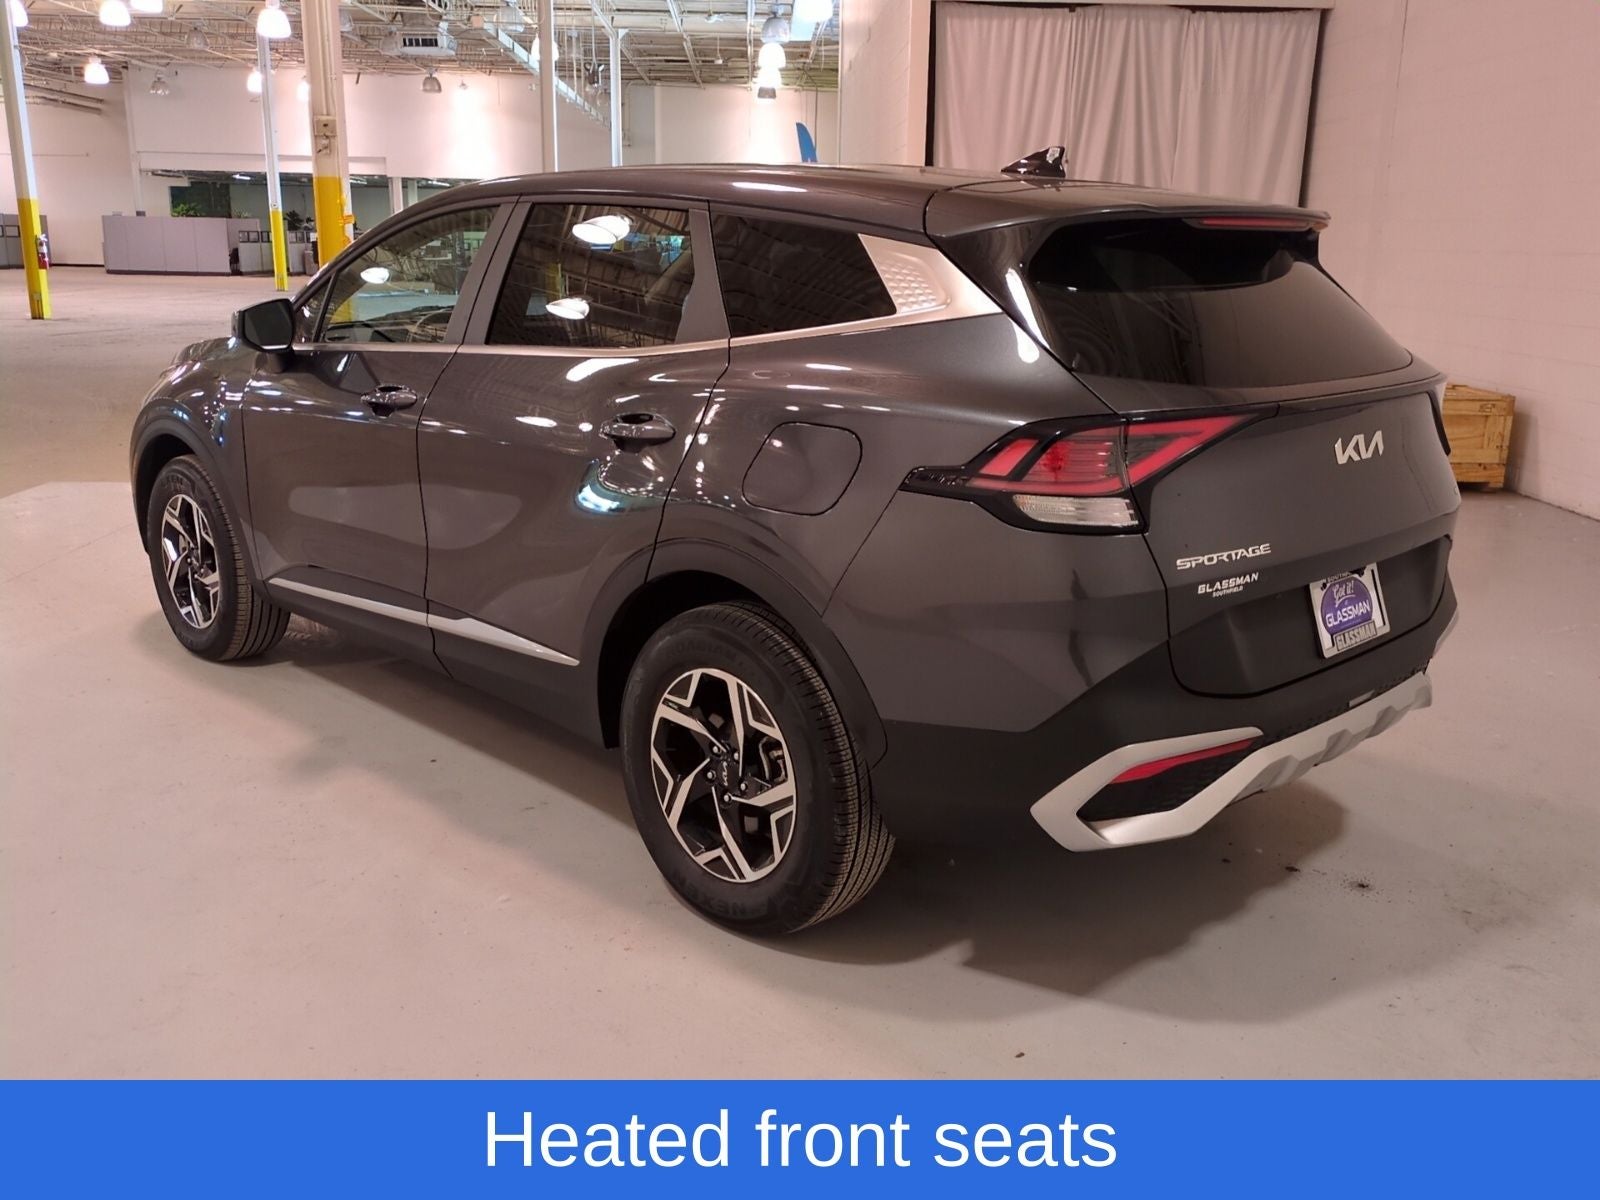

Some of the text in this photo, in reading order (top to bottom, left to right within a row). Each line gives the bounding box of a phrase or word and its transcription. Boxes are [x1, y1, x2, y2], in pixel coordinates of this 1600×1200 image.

[1334, 430, 1385, 465] KIA
[1175, 543, 1272, 570] SPORTAGE
[1197, 572, 1259, 595] GLASSMAN
[1325, 599, 1371, 628] GLASSMAN
[1336, 622, 1377, 649] GLASSMAN
